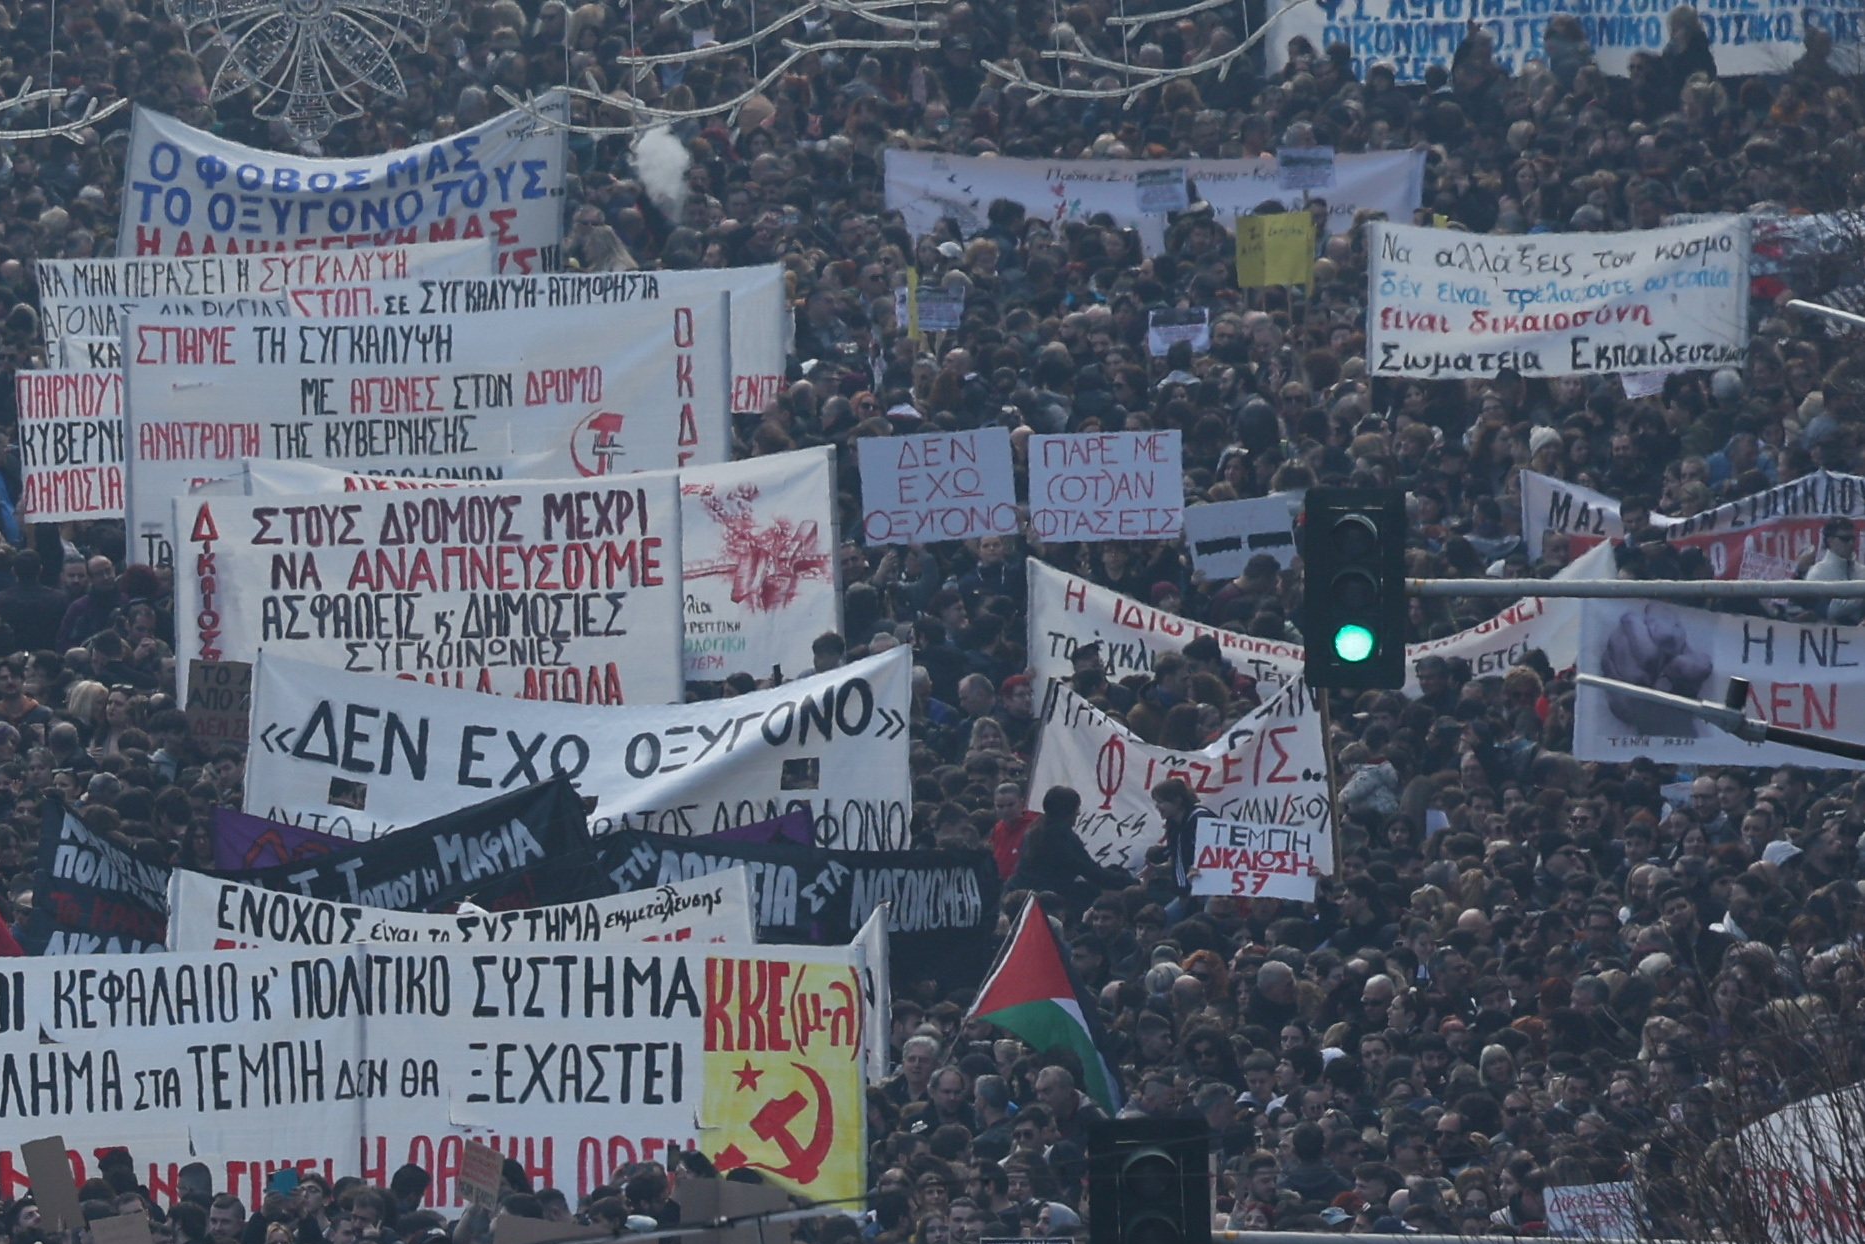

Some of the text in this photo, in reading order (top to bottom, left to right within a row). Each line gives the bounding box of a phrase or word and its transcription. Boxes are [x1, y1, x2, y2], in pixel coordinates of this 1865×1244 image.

[149, 135, 481, 194] Ο ΦΟΒΟΣ ΜΑΣ
[132, 183, 424, 235] ΤΟ ΟΞΥΓΟΝΟ
[429, 206, 518, 243] ΜΑΣ
[1382, 232, 1411, 263] Να
[39, 264, 65, 298] ΝΑ
[73, 263, 117, 298] ΜΗΝ
[260, 249, 408, 294] ΣΥΓΚΑΛΥΨΗ
[384, 294, 411, 315] ΣΕ
[136, 323, 454, 365] ΣΠΑΜΕ ΤΗ ΣΥΓΚΑΛΥΨΗ
[301, 365, 602, 416] ΜΕ ΑΓΩΝΕΣ ΣΤΟΝ ΔΡΟΜΟ
[139, 415, 479, 461] ΑΝΑΤΡΟΠΗ ΤΗΣ ΚΥΒΕΡΝΗΣΗΣ
[898, 435, 977, 470] ΔΕΝ
[1043, 433, 1170, 469] ΠΑΡΕ ΜΕ
[898, 467, 985, 505] ΕΧΩ
[1047, 469, 1154, 508] (ΟΤ)ΑΝ
[251, 487, 648, 545] ΣΤΟΥΣ ΔΡΟΜΟΥΣ ΜΕΧΡΙ
[863, 503, 1019, 544] ΟΞΥΓΟΝΟ
[1032, 507, 1182, 537] ΦΤΑΣΕΙΣ
[1549, 490, 1607, 537] ΜΑΣ
[271, 536, 663, 592] ΝΑ ΑΝΑΠΝΕΥΣΟΥΜΕ
[261, 590, 627, 641] ΑΣΦΑΛΕΙΣ ΔΗΜΟΣΙΕΣ
[1064, 580, 1087, 613] Η
[345, 636, 570, 673] ΣΥΓΚΟΙΝΩΝΙΕΣ
[1742, 620, 1774, 666] Η
[434, 818, 546, 885] ΜΑΦΙΑ
[1210, 822, 1312, 855] ΤΕΜΠΗ
[1197, 843, 1316, 877] ΔΙΚΑΙΩΣΗ
[1230, 871, 1270, 896] 57
[217, 885, 363, 945] ΕΝΟΧΟΣ
[456, 902, 602, 944] ΣΥΣΤΗΜΑ
[53, 961, 238, 1029] ΚΕΦΑΛΑΙΟ
[290, 954, 451, 1020] ΠΟΛΙΤΙΚΟ
[471, 956, 701, 1019] ΣΥΣΤΗΜΑ
[703, 957, 792, 1052] ΚΚΕ
[134, 1066, 182, 1110] ΣΤΑ
[187, 1039, 326, 1111] ΤΕΜΠΗ
[335, 1056, 389, 1101] ΔΕΝ
[401, 1058, 440, 1099] ΘΑ
[466, 1042, 684, 1105] ΞΕΧΑΣΤΕΙ
